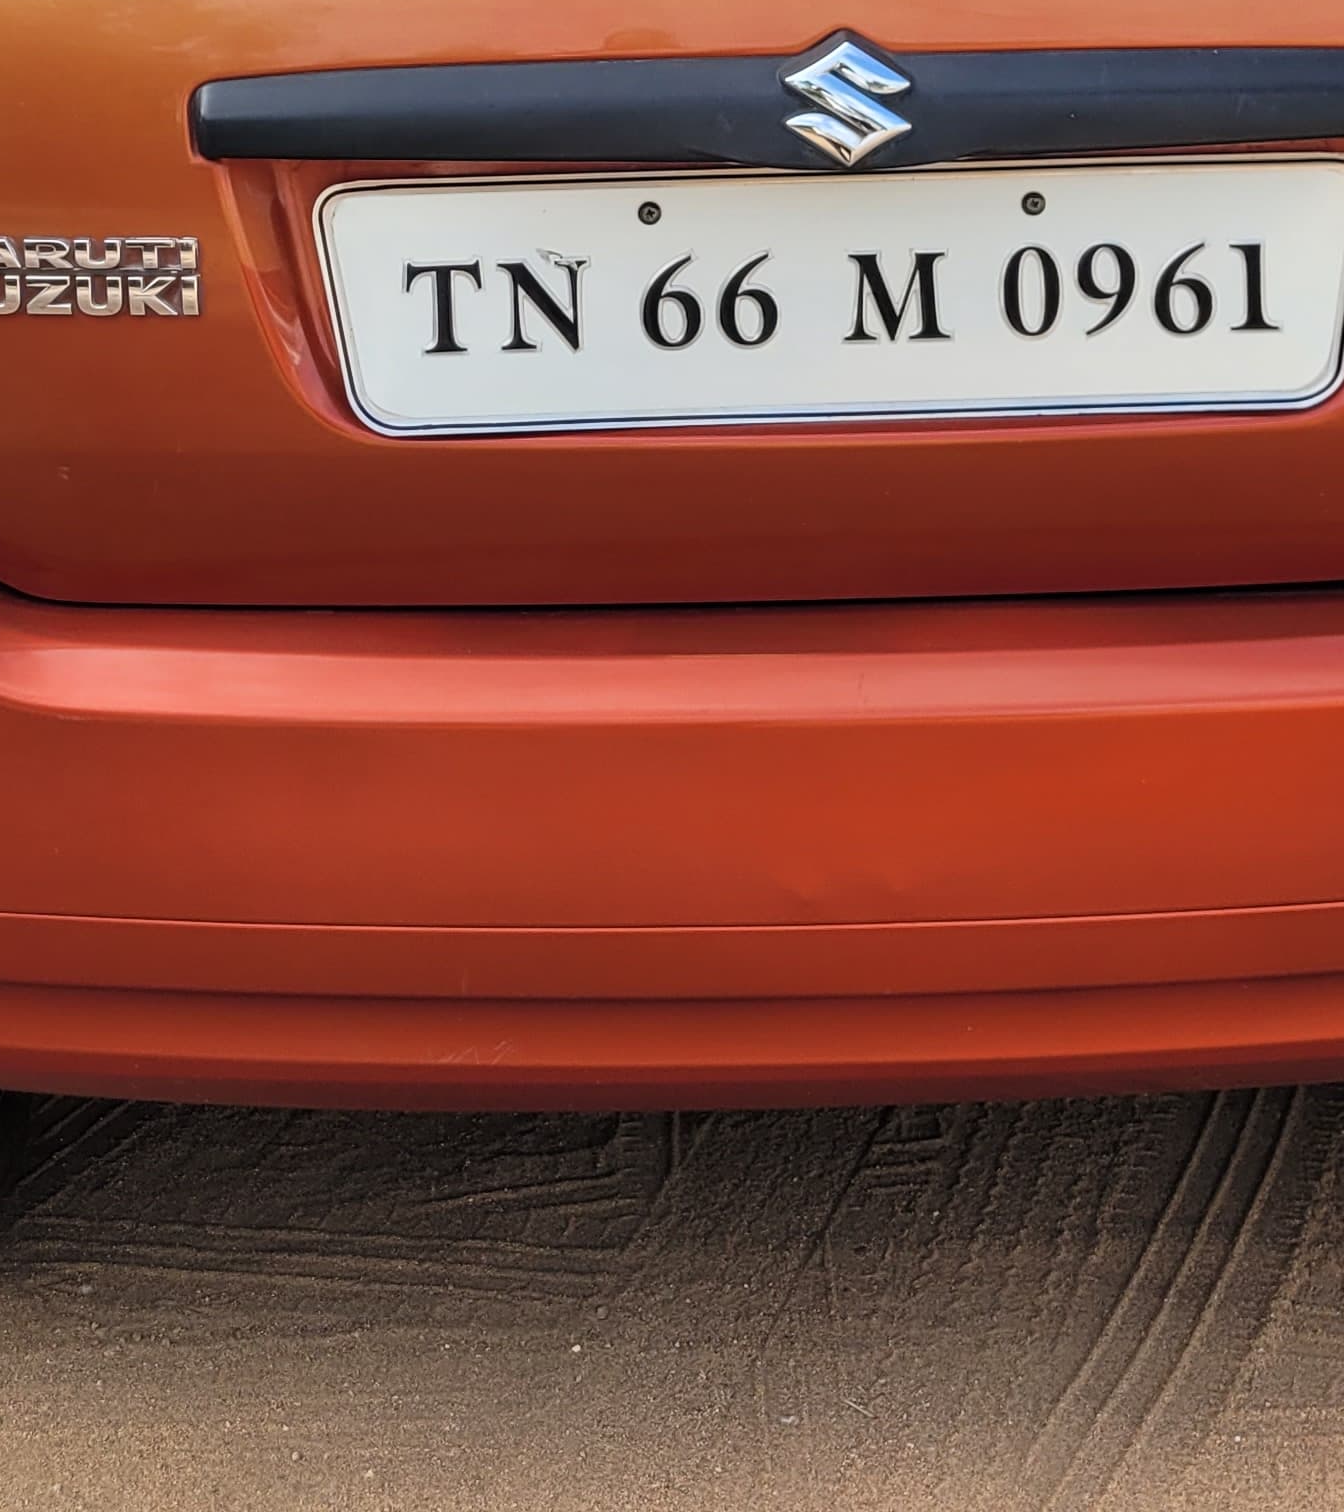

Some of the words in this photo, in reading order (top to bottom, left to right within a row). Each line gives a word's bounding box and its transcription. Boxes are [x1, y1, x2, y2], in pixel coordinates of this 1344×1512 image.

[403, 252, 591, 355] TN
[641, 251, 780, 350] 66
[842, 249, 953, 344] M
[1000, 240, 1282, 338] 0961
